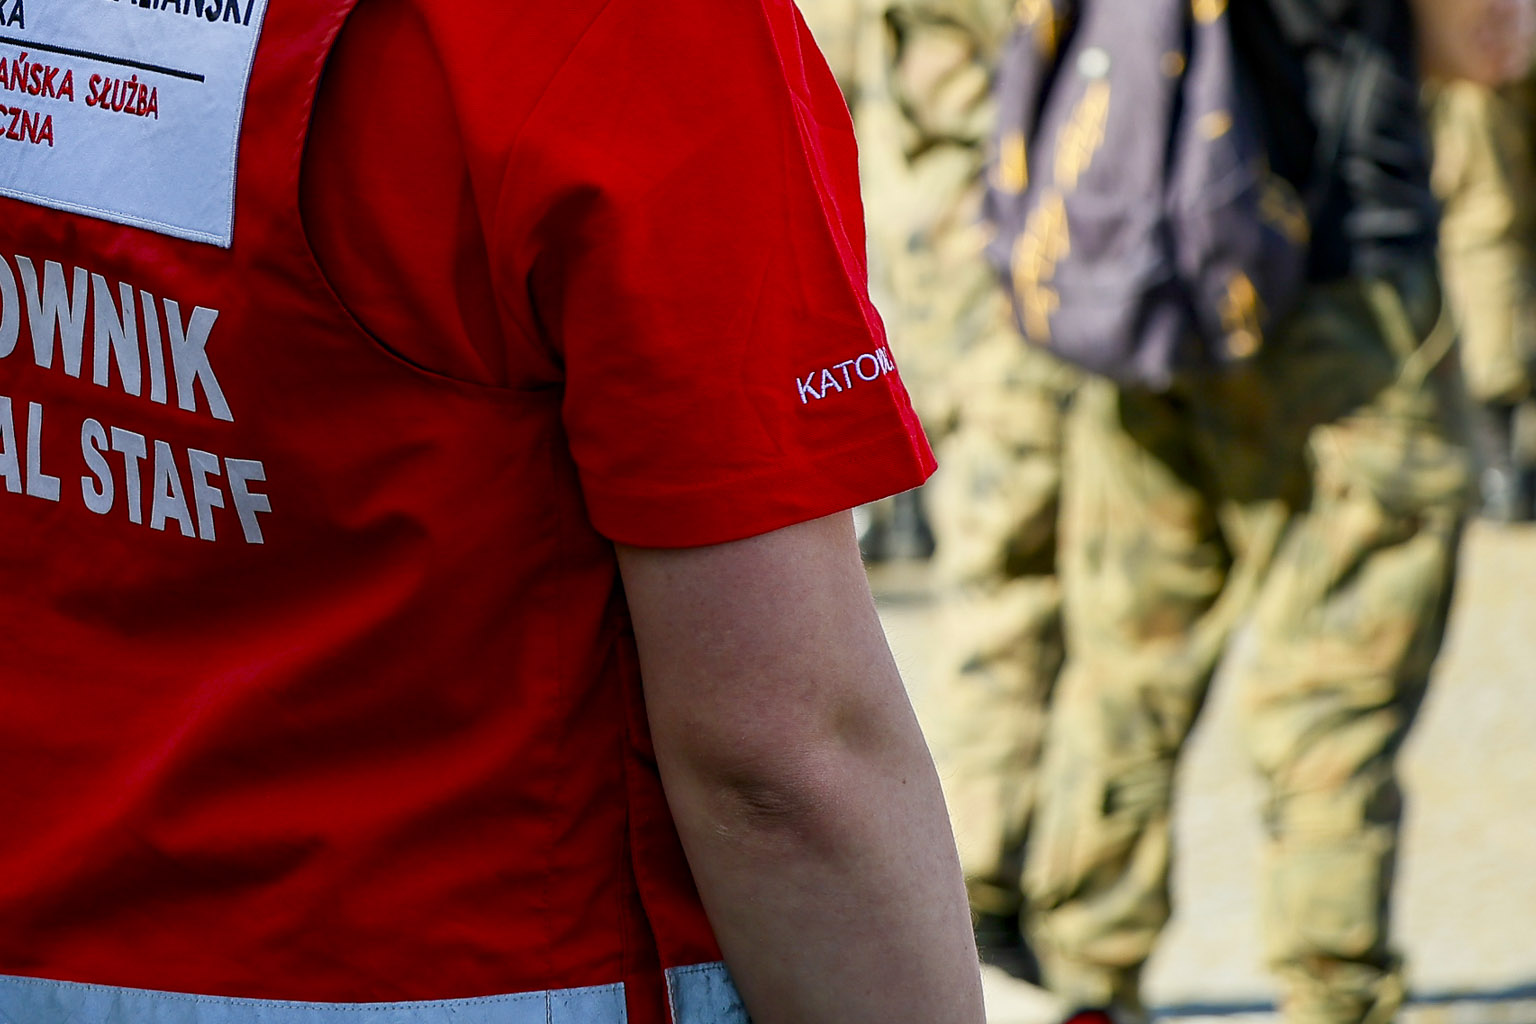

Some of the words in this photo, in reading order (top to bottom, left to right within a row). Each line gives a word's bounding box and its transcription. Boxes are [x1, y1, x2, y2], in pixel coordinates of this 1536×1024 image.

[85, 73, 158, 120] SŁUŻBA
[796, 346, 895, 405] KATOW
[80, 417, 272, 544] STAFF
